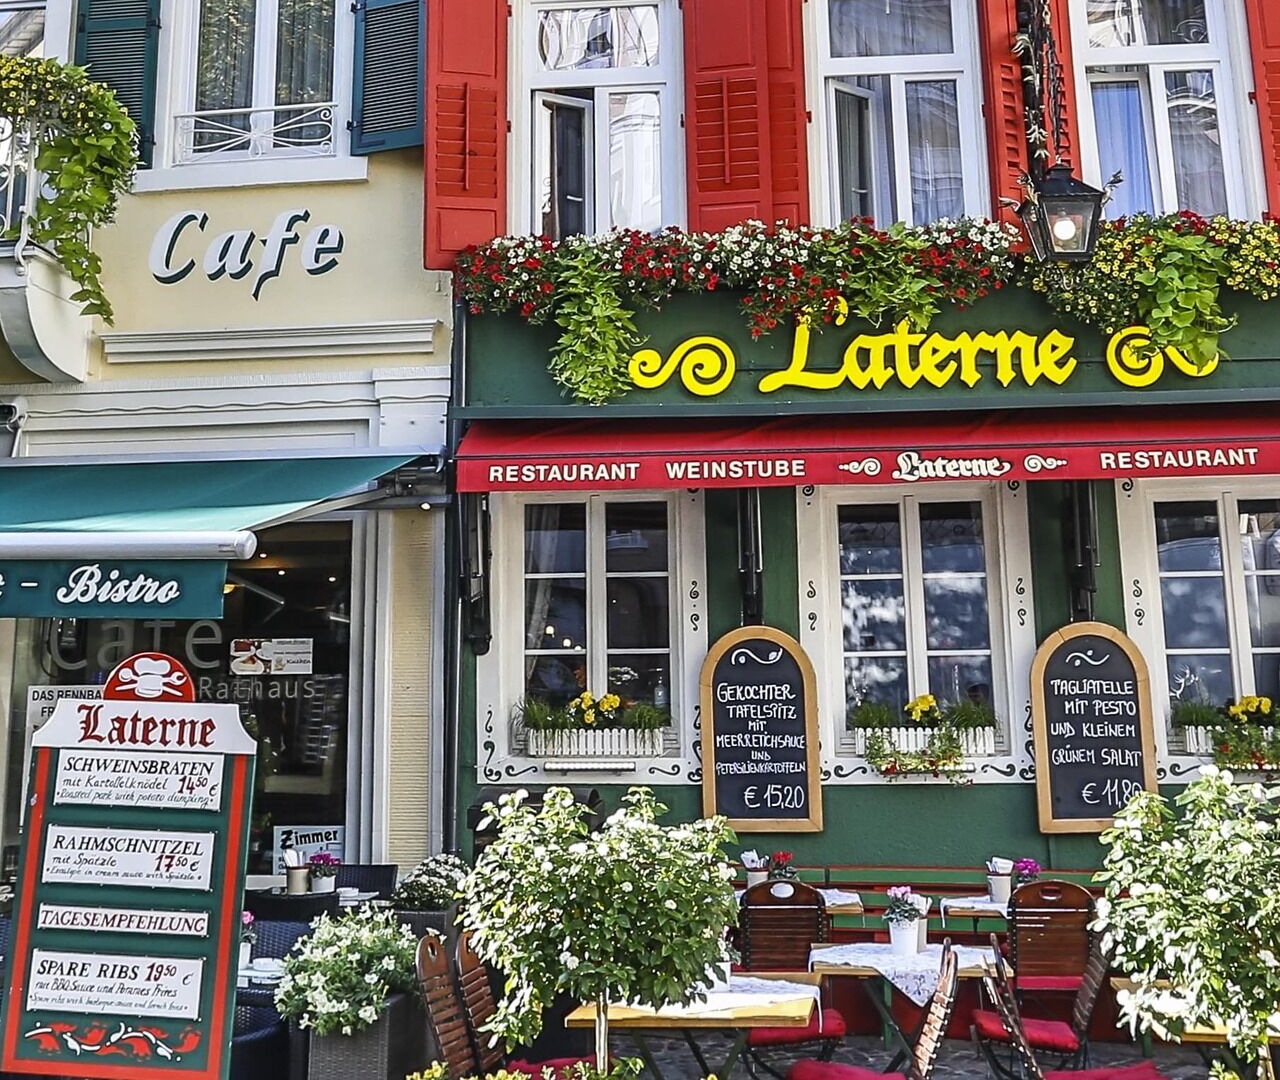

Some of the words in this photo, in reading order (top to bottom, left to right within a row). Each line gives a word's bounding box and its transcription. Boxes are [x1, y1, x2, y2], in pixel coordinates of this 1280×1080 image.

[149, 209, 344, 301] Cafe
[758, 296, 1077, 393] Laterne
[489, 462, 640, 482] RESTAURANT
[665, 459, 806, 479] WEINSTUBE
[892, 451, 1012, 481] Laterne
[1100, 447, 1258, 469] RESTAURANT
[56, 564, 181, 603] Bistro
[32, 690, 54, 701] DAS
[201, 675, 315, 699] Rathaus
[717, 682, 796, 702] GEKOCHTER
[1050, 679, 1133, 695] TAGLIATELLE
[726, 703, 797, 719] TAFELSPITZ
[1065, 699, 1088, 715] MIT
[1092, 700, 1136, 716] PESTO
[77, 703, 216, 748] Laterne
[1051, 722, 1075, 738] UND
[1082, 721, 1135, 737] KLEINEM
[716, 732, 805, 749] MEERRETICHSAUCE
[751, 750, 771, 761] UND
[1101, 748, 1142, 767] SALAT
[64, 756, 215, 777] SCHWEINSBRATEN
[62, 777, 80, 788] mit
[85, 775, 168, 790] Kartoffelknödel
[744, 786, 760, 808] €
[763, 784, 805, 809] 15,20
[1081, 783, 1100, 803] €
[53, 835, 205, 856] RAHMSCHNITZEL
[280, 830, 338, 850] Zimmer
[52, 856, 70, 865] mit
[73, 853, 117, 868] Spätzle
[40, 910, 206, 932] TAGESEMPFEHLUNG
[37, 960, 91, 977] SPARE
[96, 963, 140, 980] RIBS
